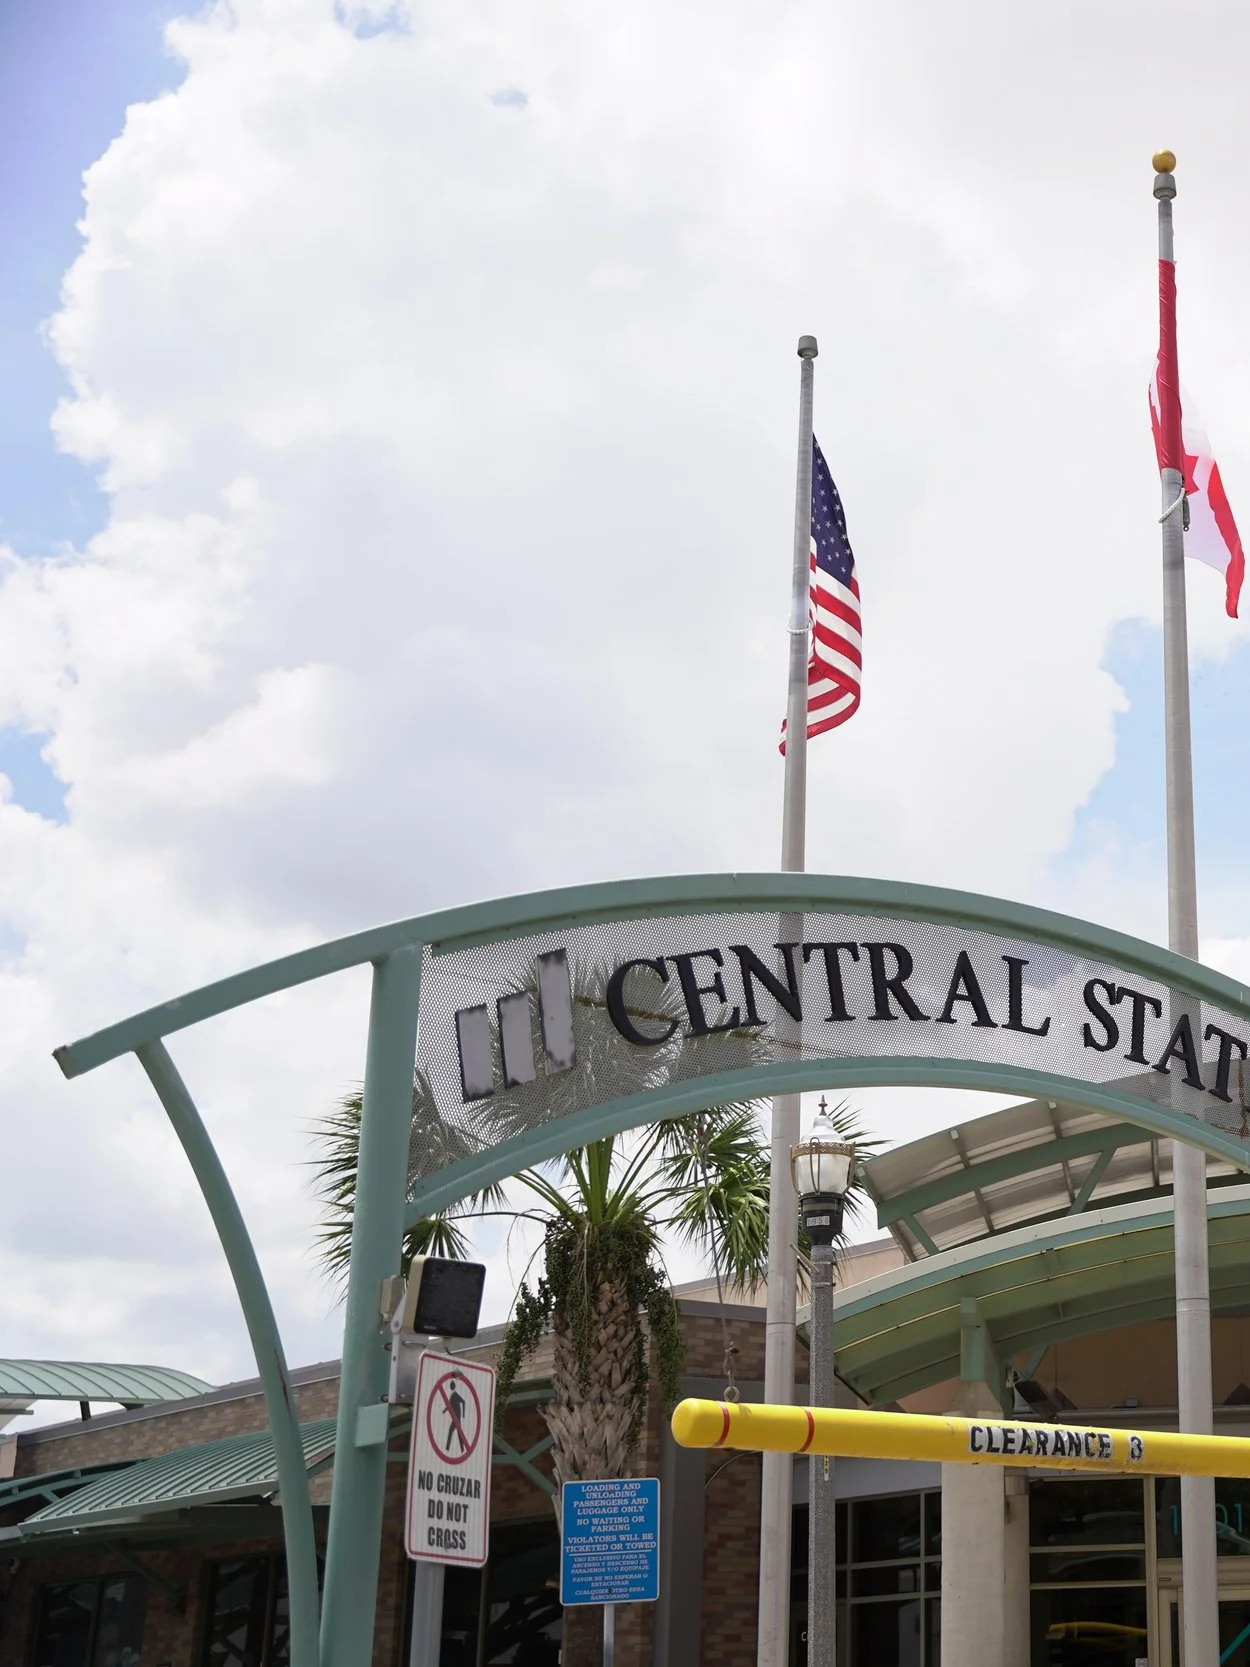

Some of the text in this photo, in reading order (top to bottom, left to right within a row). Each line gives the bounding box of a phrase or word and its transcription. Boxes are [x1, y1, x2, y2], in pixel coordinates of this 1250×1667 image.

[606, 942, 1051, 1047] CENTRAL
[970, 1426, 1112, 1459] CLEARANCE
[418, 1470, 481, 1499] NO CRUZAR
[581, 1483, 641, 1492] LOADING AND
[586, 1490, 636, 1499] UNLOADING
[573, 1497, 648, 1508] PASSENGERS AND
[428, 1498, 469, 1523] DO NOT
[577, 1505, 644, 1515] LUGGAGE ONLY
[576, 1515, 645, 1526] NO WAITING OR
[1170, 1502, 1244, 1535] 101
[591, 1524, 631, 1533] PARKING
[428, 1526, 466, 1550] CROSS
[568, 1535, 617, 1544] VIOLATORS
[565, 1544, 608, 1553] TICKETED
[625, 1541, 656, 1549] TOWED
[590, 1593, 629, 1601] SANCIONADO
